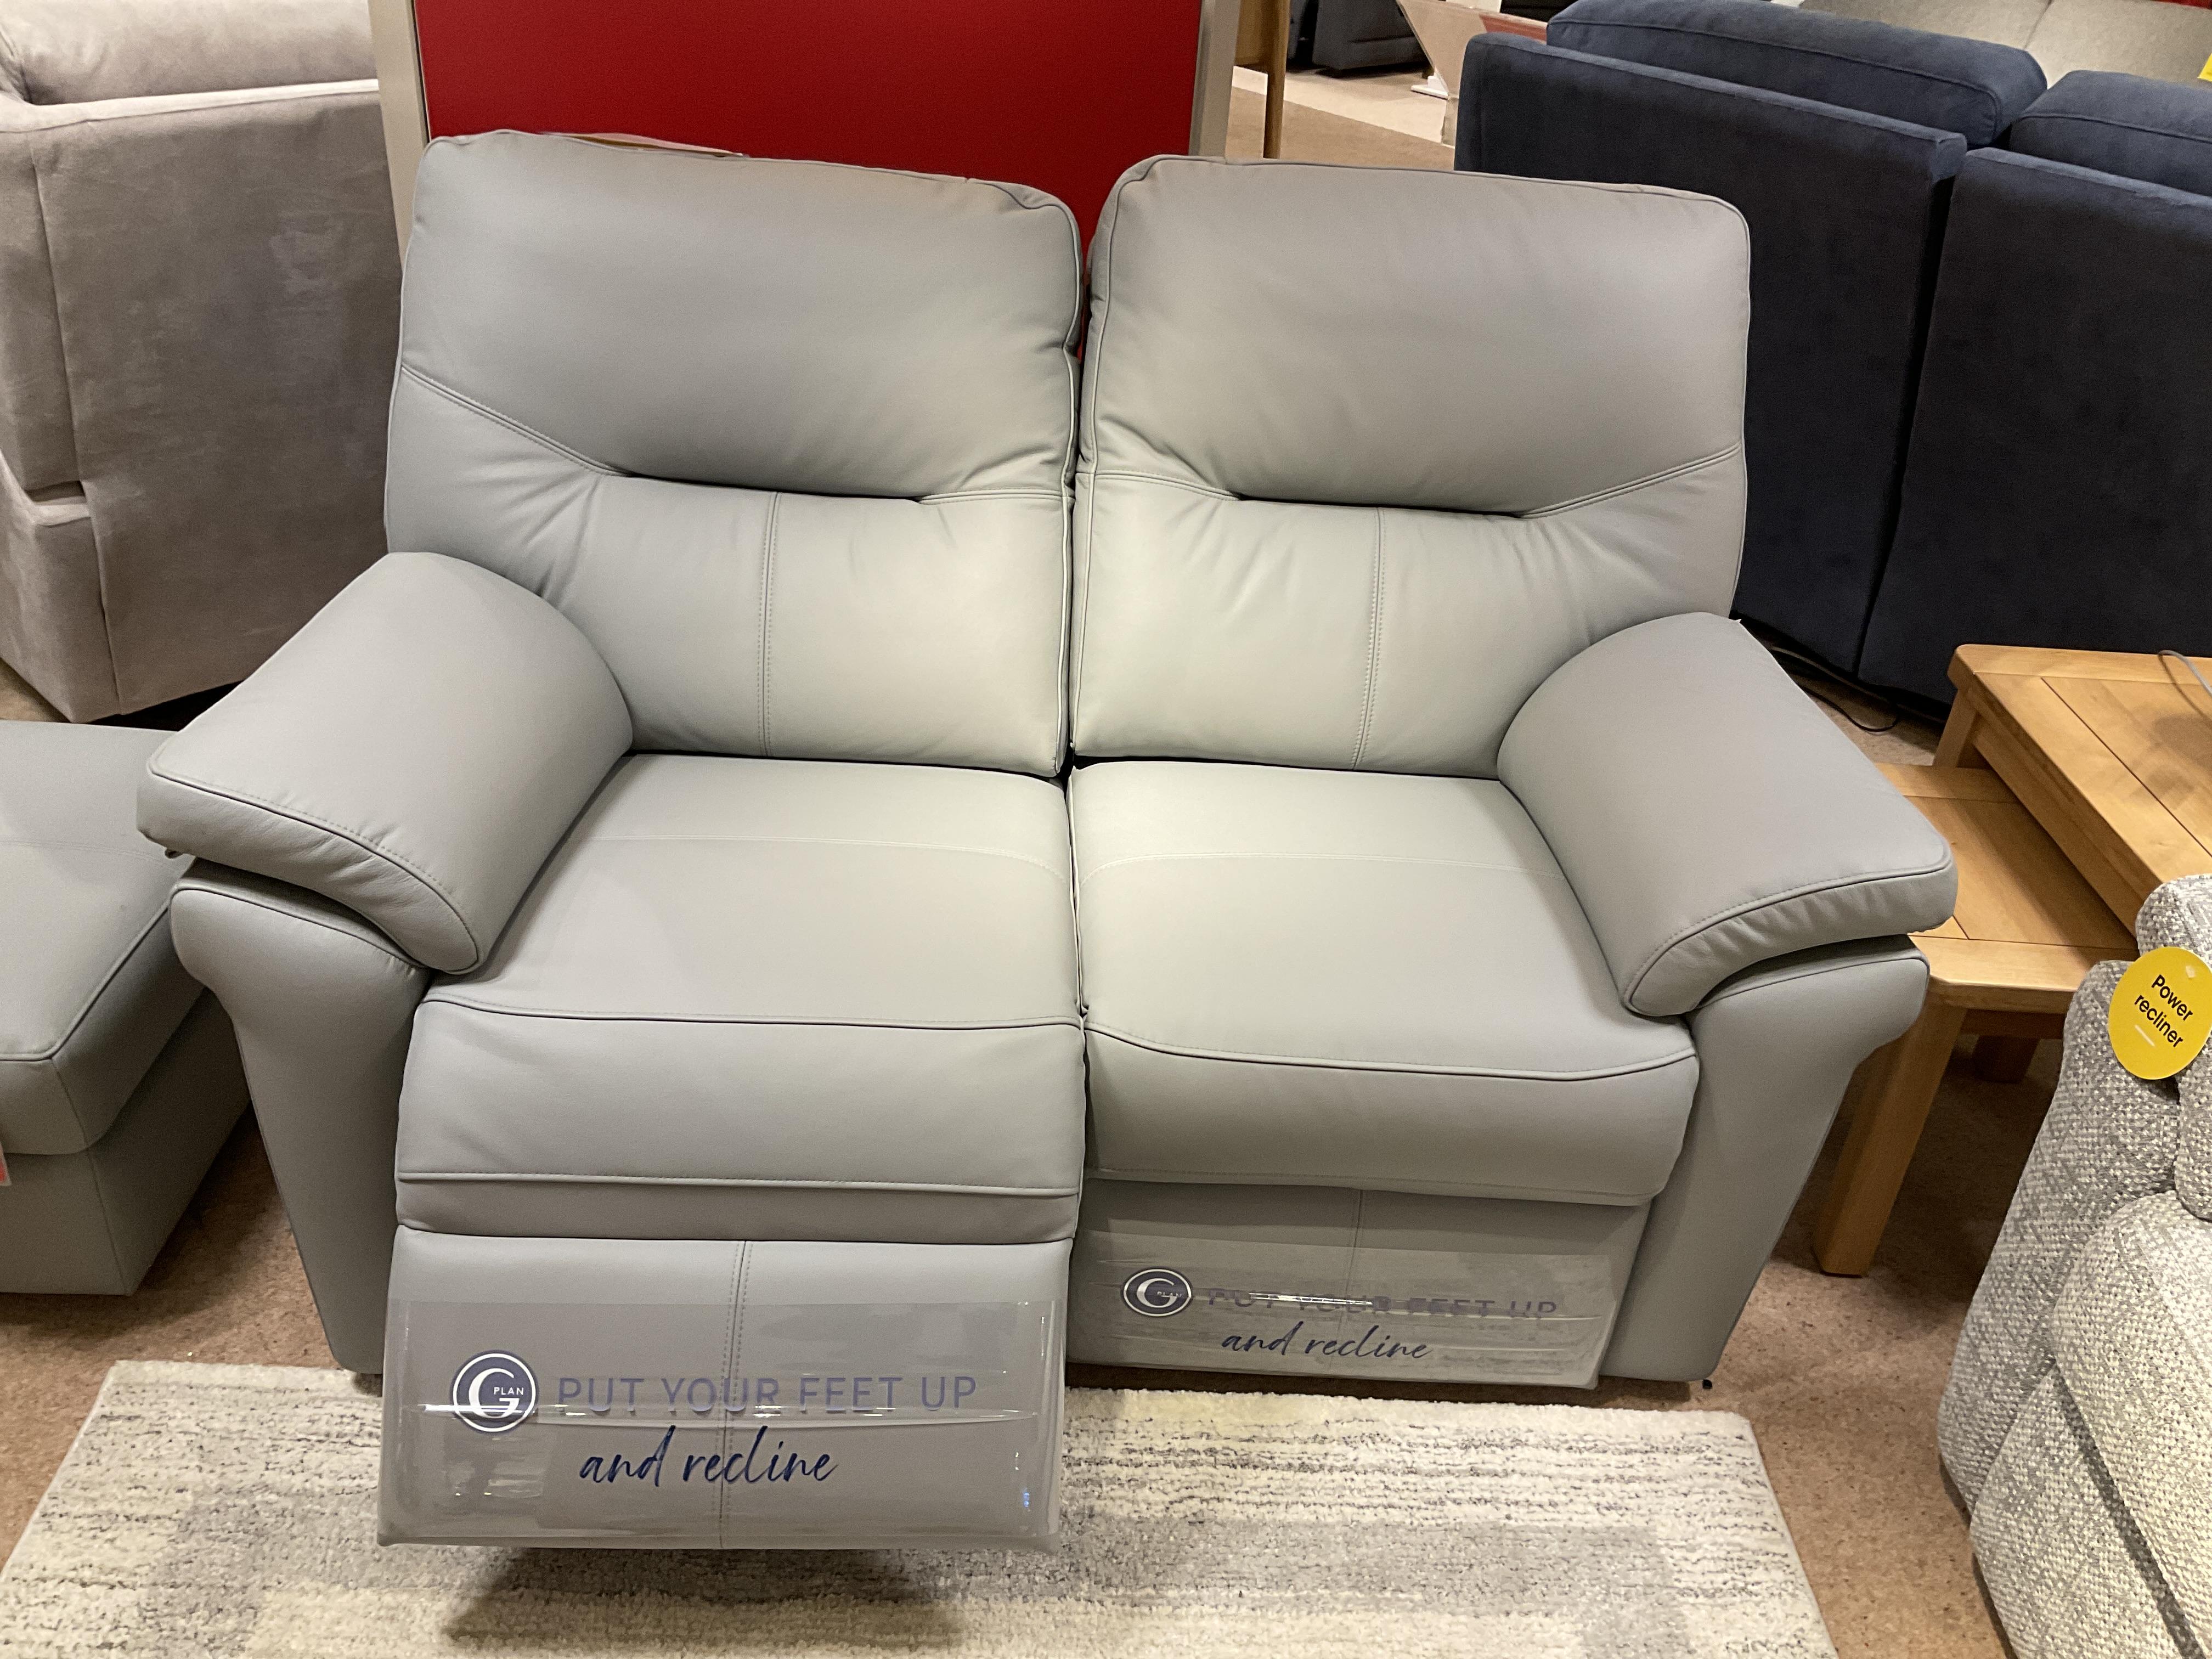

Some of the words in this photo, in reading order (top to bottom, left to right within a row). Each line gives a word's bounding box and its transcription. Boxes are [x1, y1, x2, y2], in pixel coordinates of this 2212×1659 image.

[2151, 974, 2193, 1021] Power
[2134, 995, 2183, 1048] recliner
[1136, 1278, 1178, 1308] G
[1221, 1321, 1304, 1356] and
[1305, 1324, 1432, 1359] recline
[468, 1368, 520, 1419] G
[493, 1386, 524, 1396] PLAN
[558, 1377, 645, 1412] PUT
[661, 1377, 782, 1413] YOUR
[799, 1376, 903, 1412] FEET
[921, 1376, 977, 1411] UP
[579, 1424, 676, 1487] and
[682, 1425, 839, 1483] recline
